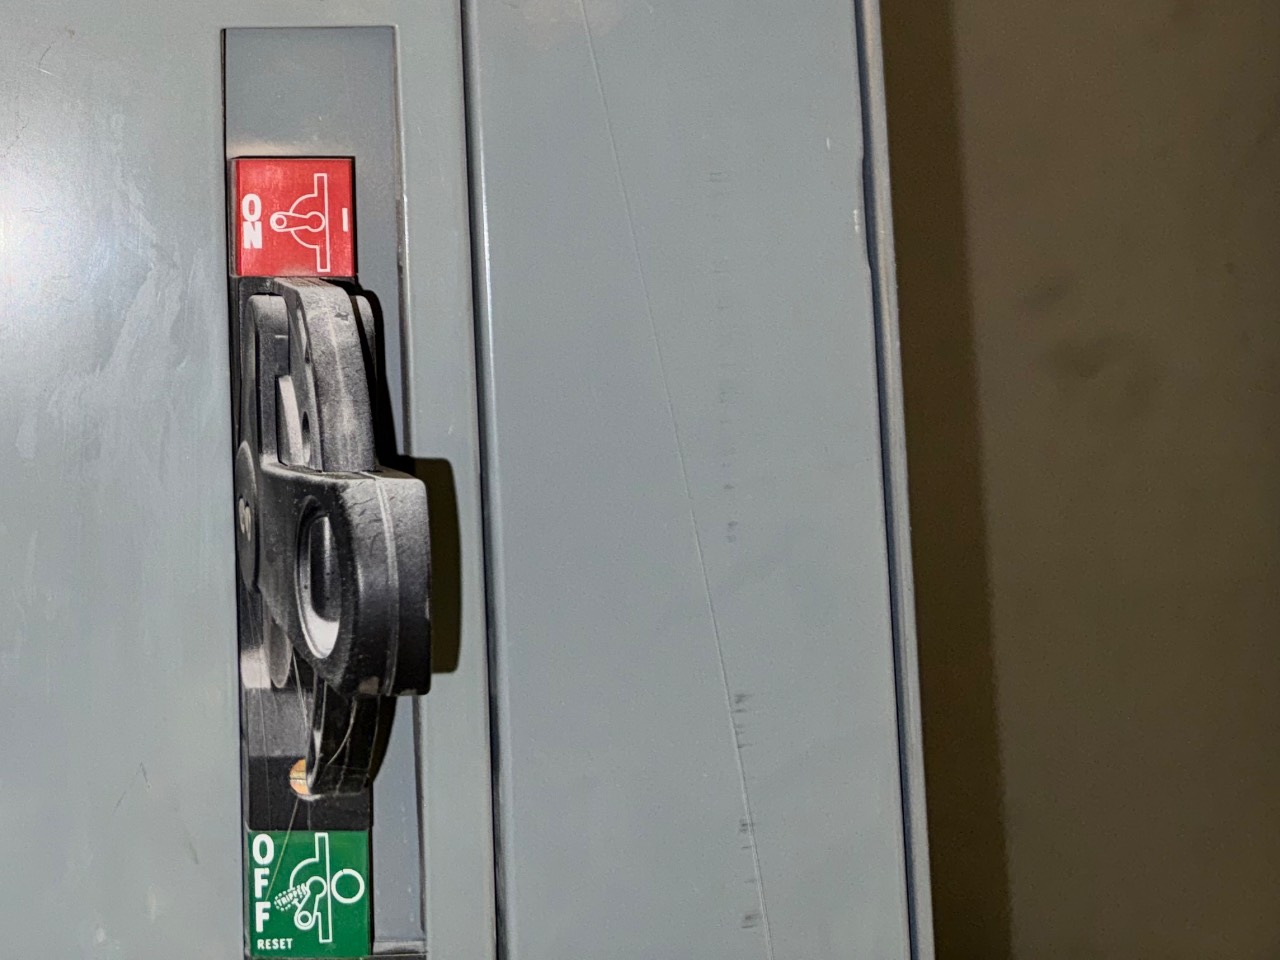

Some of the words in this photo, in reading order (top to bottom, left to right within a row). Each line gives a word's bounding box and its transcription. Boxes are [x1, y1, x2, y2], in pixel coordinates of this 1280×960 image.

[242, 193, 263, 249] ON
[252, 833, 275, 933] OFF
[257, 938, 293, 950] RESET
